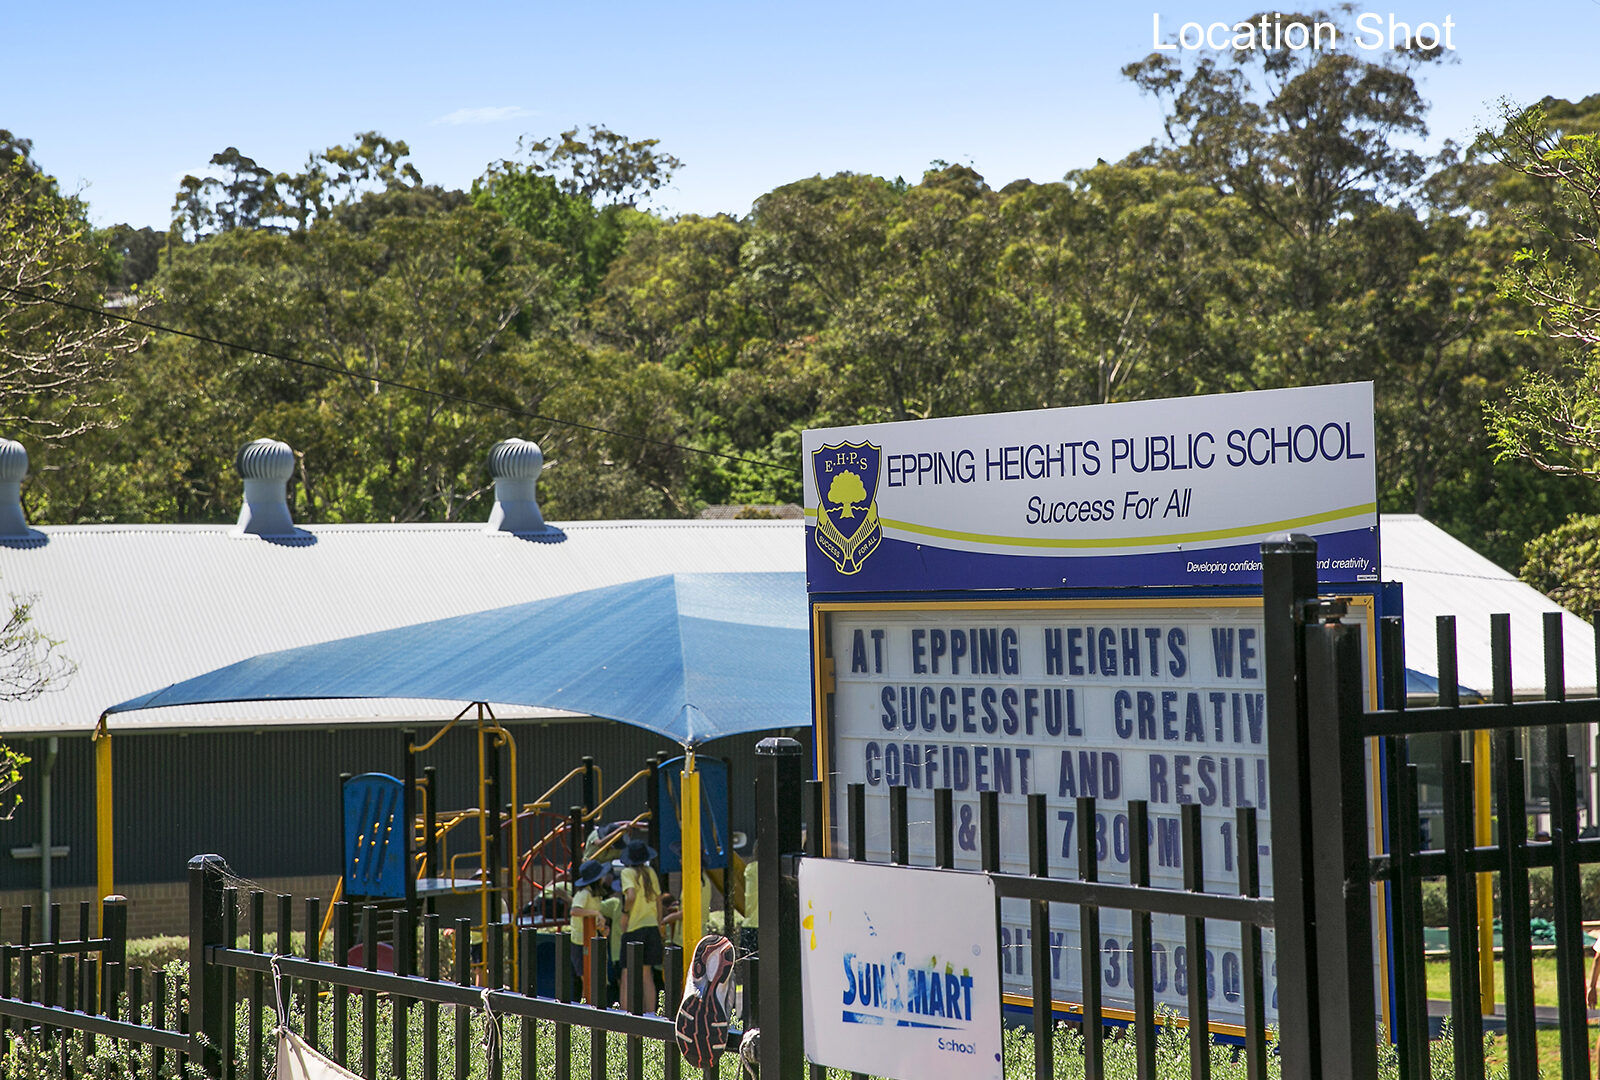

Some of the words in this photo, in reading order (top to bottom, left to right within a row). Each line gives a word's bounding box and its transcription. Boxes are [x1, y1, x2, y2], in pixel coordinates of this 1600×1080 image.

[887, 449, 976, 487] EPPING
[985, 440, 1101, 482] HEIGHTS
[1111, 431, 1216, 474] PUBLIC
[1226, 421, 1366, 467] SCHOOL
[1026, 495, 1115, 525] Success
[1122, 490, 1160, 520] For
[1163, 487, 1192, 519] All
[819, 535, 840, 559] SUCCESS
[1186, 561, 1227, 574] Developing
[1331, 557, 1370, 570] creativity
[851, 629, 884, 674] AT
[912, 628, 1019, 676] EPPING
[1044, 627, 1187, 678] HEIGHTS
[1212, 627, 1258, 679] WE
[881, 686, 1083, 737] SUCCESSFUL
[1114, 689, 1265, 744] CREATIV
[866, 741, 1030, 796] CONFIDENT
[1058, 751, 1121, 801] AND
[1149, 754, 1267, 810] RESILI
[958, 803, 976, 851] &
